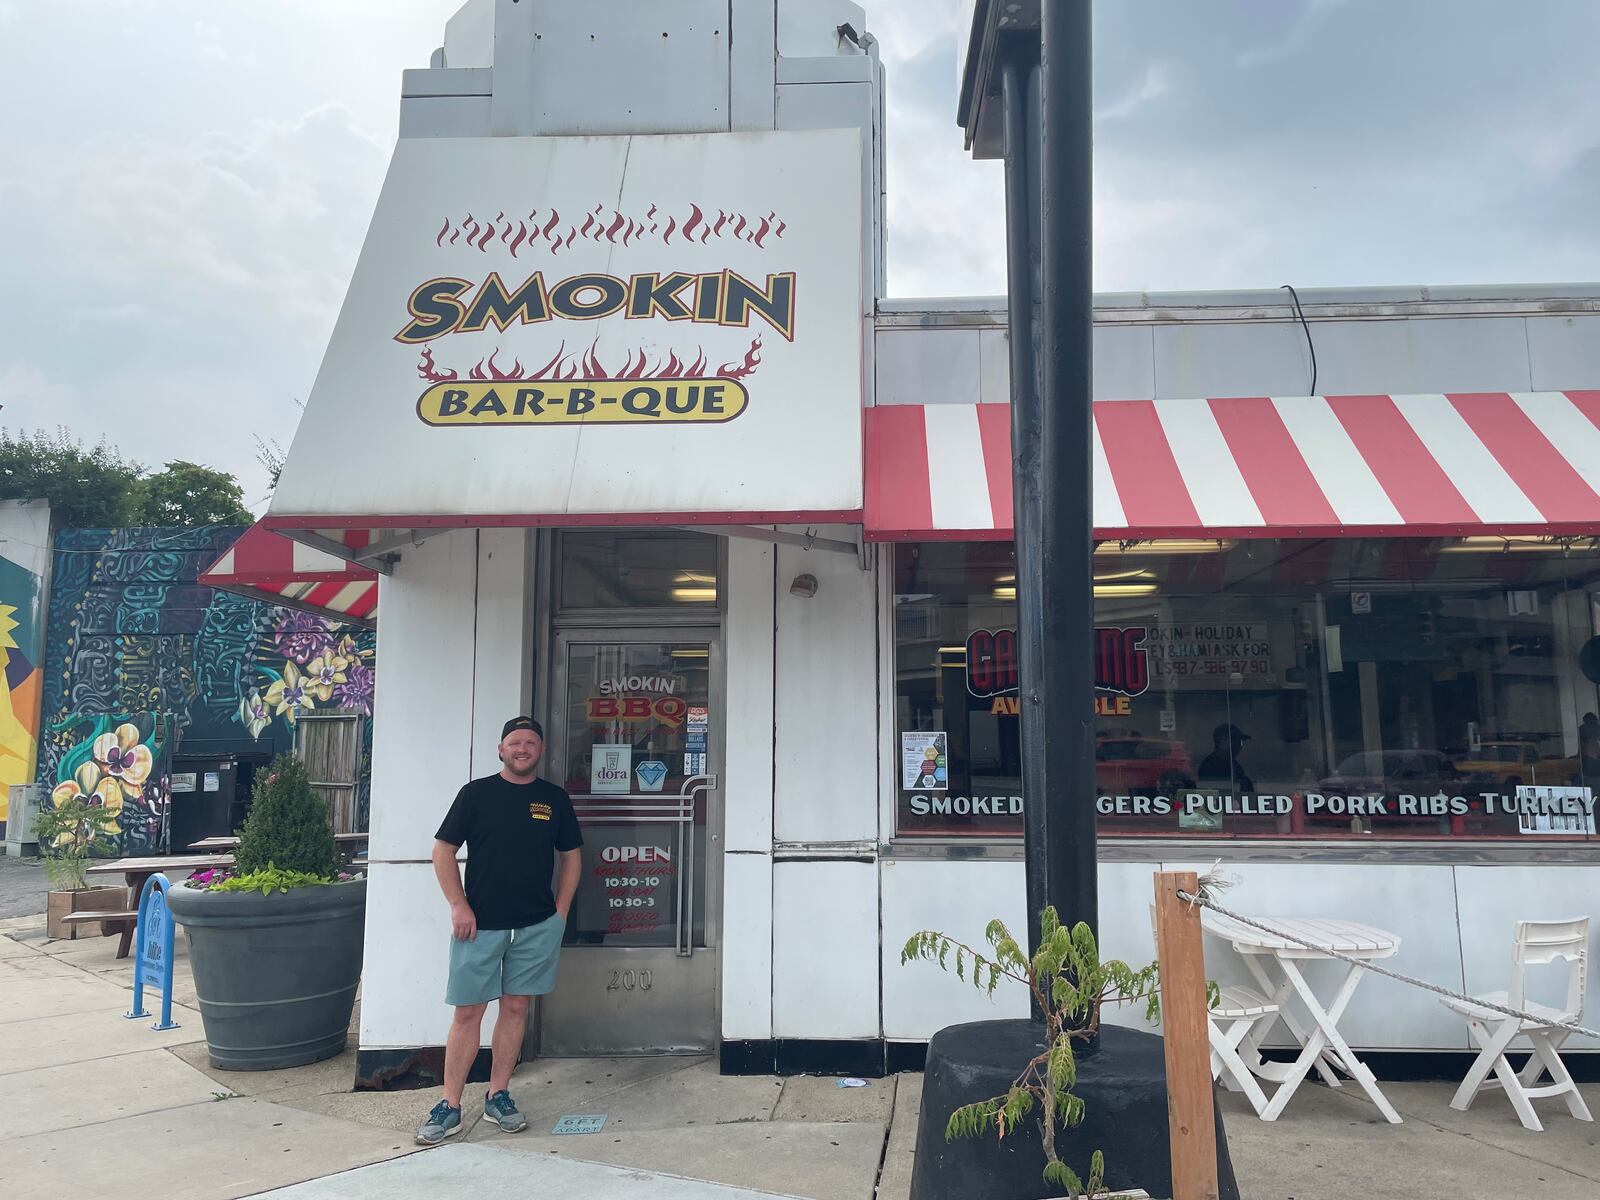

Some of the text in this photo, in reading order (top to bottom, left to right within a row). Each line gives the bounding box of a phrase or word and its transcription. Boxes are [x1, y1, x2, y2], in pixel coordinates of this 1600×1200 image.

[393, 268, 796, 344] SMOKIN
[437, 385, 726, 417] BAR-B-QUE
[1147, 626, 1253, 640] OKIN HOLIDAY
[1214, 643, 1240, 657] ASK
[1243, 642, 1269, 657] FOR
[967, 628, 1149, 697] CANG
[600, 677, 676, 694] SMOKIN
[587, 697, 687, 727] BBQ
[598, 767, 627, 780] dora
[910, 795, 1024, 816] SMOKED
[1095, 796, 1171, 815] GERS
[1186, 794, 1294, 815] PULLED
[1307, 794, 1388, 815] PORK
[1399, 794, 1468, 815] RIBS
[1479, 793, 1598, 816] TURKEY
[600, 846, 671, 864] OPEN
[607, 969, 653, 991] 200
